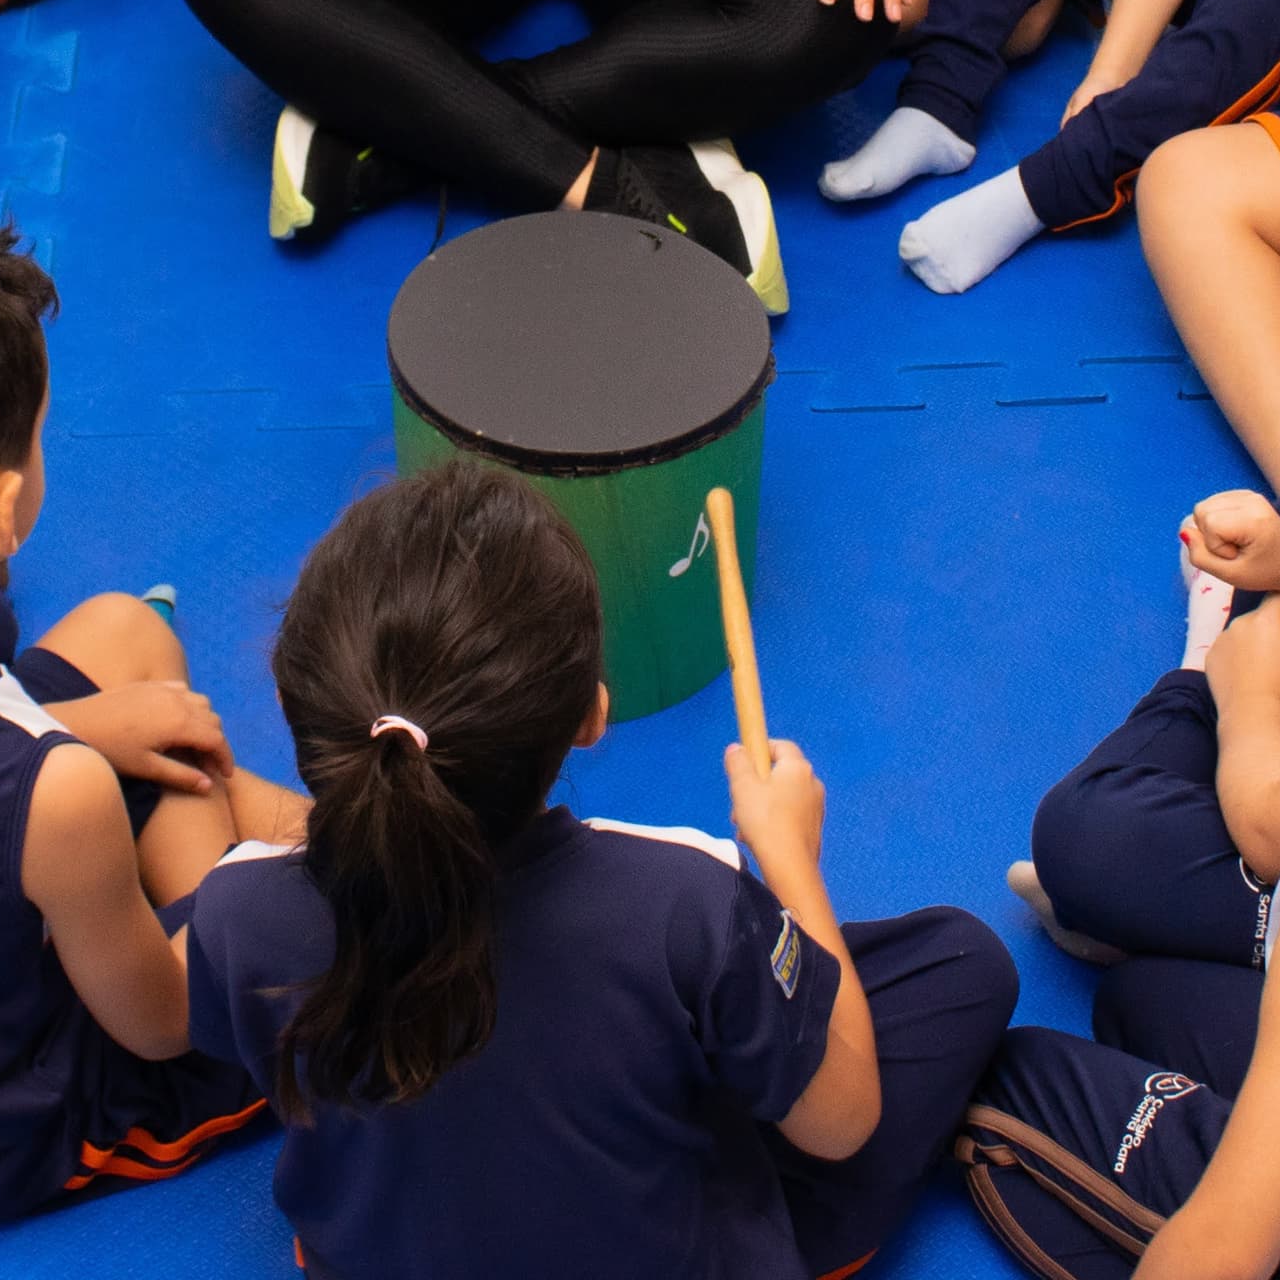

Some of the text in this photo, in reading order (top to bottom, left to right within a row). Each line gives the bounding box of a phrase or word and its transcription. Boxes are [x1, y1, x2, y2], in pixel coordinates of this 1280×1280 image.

[1114, 1094, 1156, 1173] Santa Clara
[1132, 1099, 1164, 1148] Colégio
